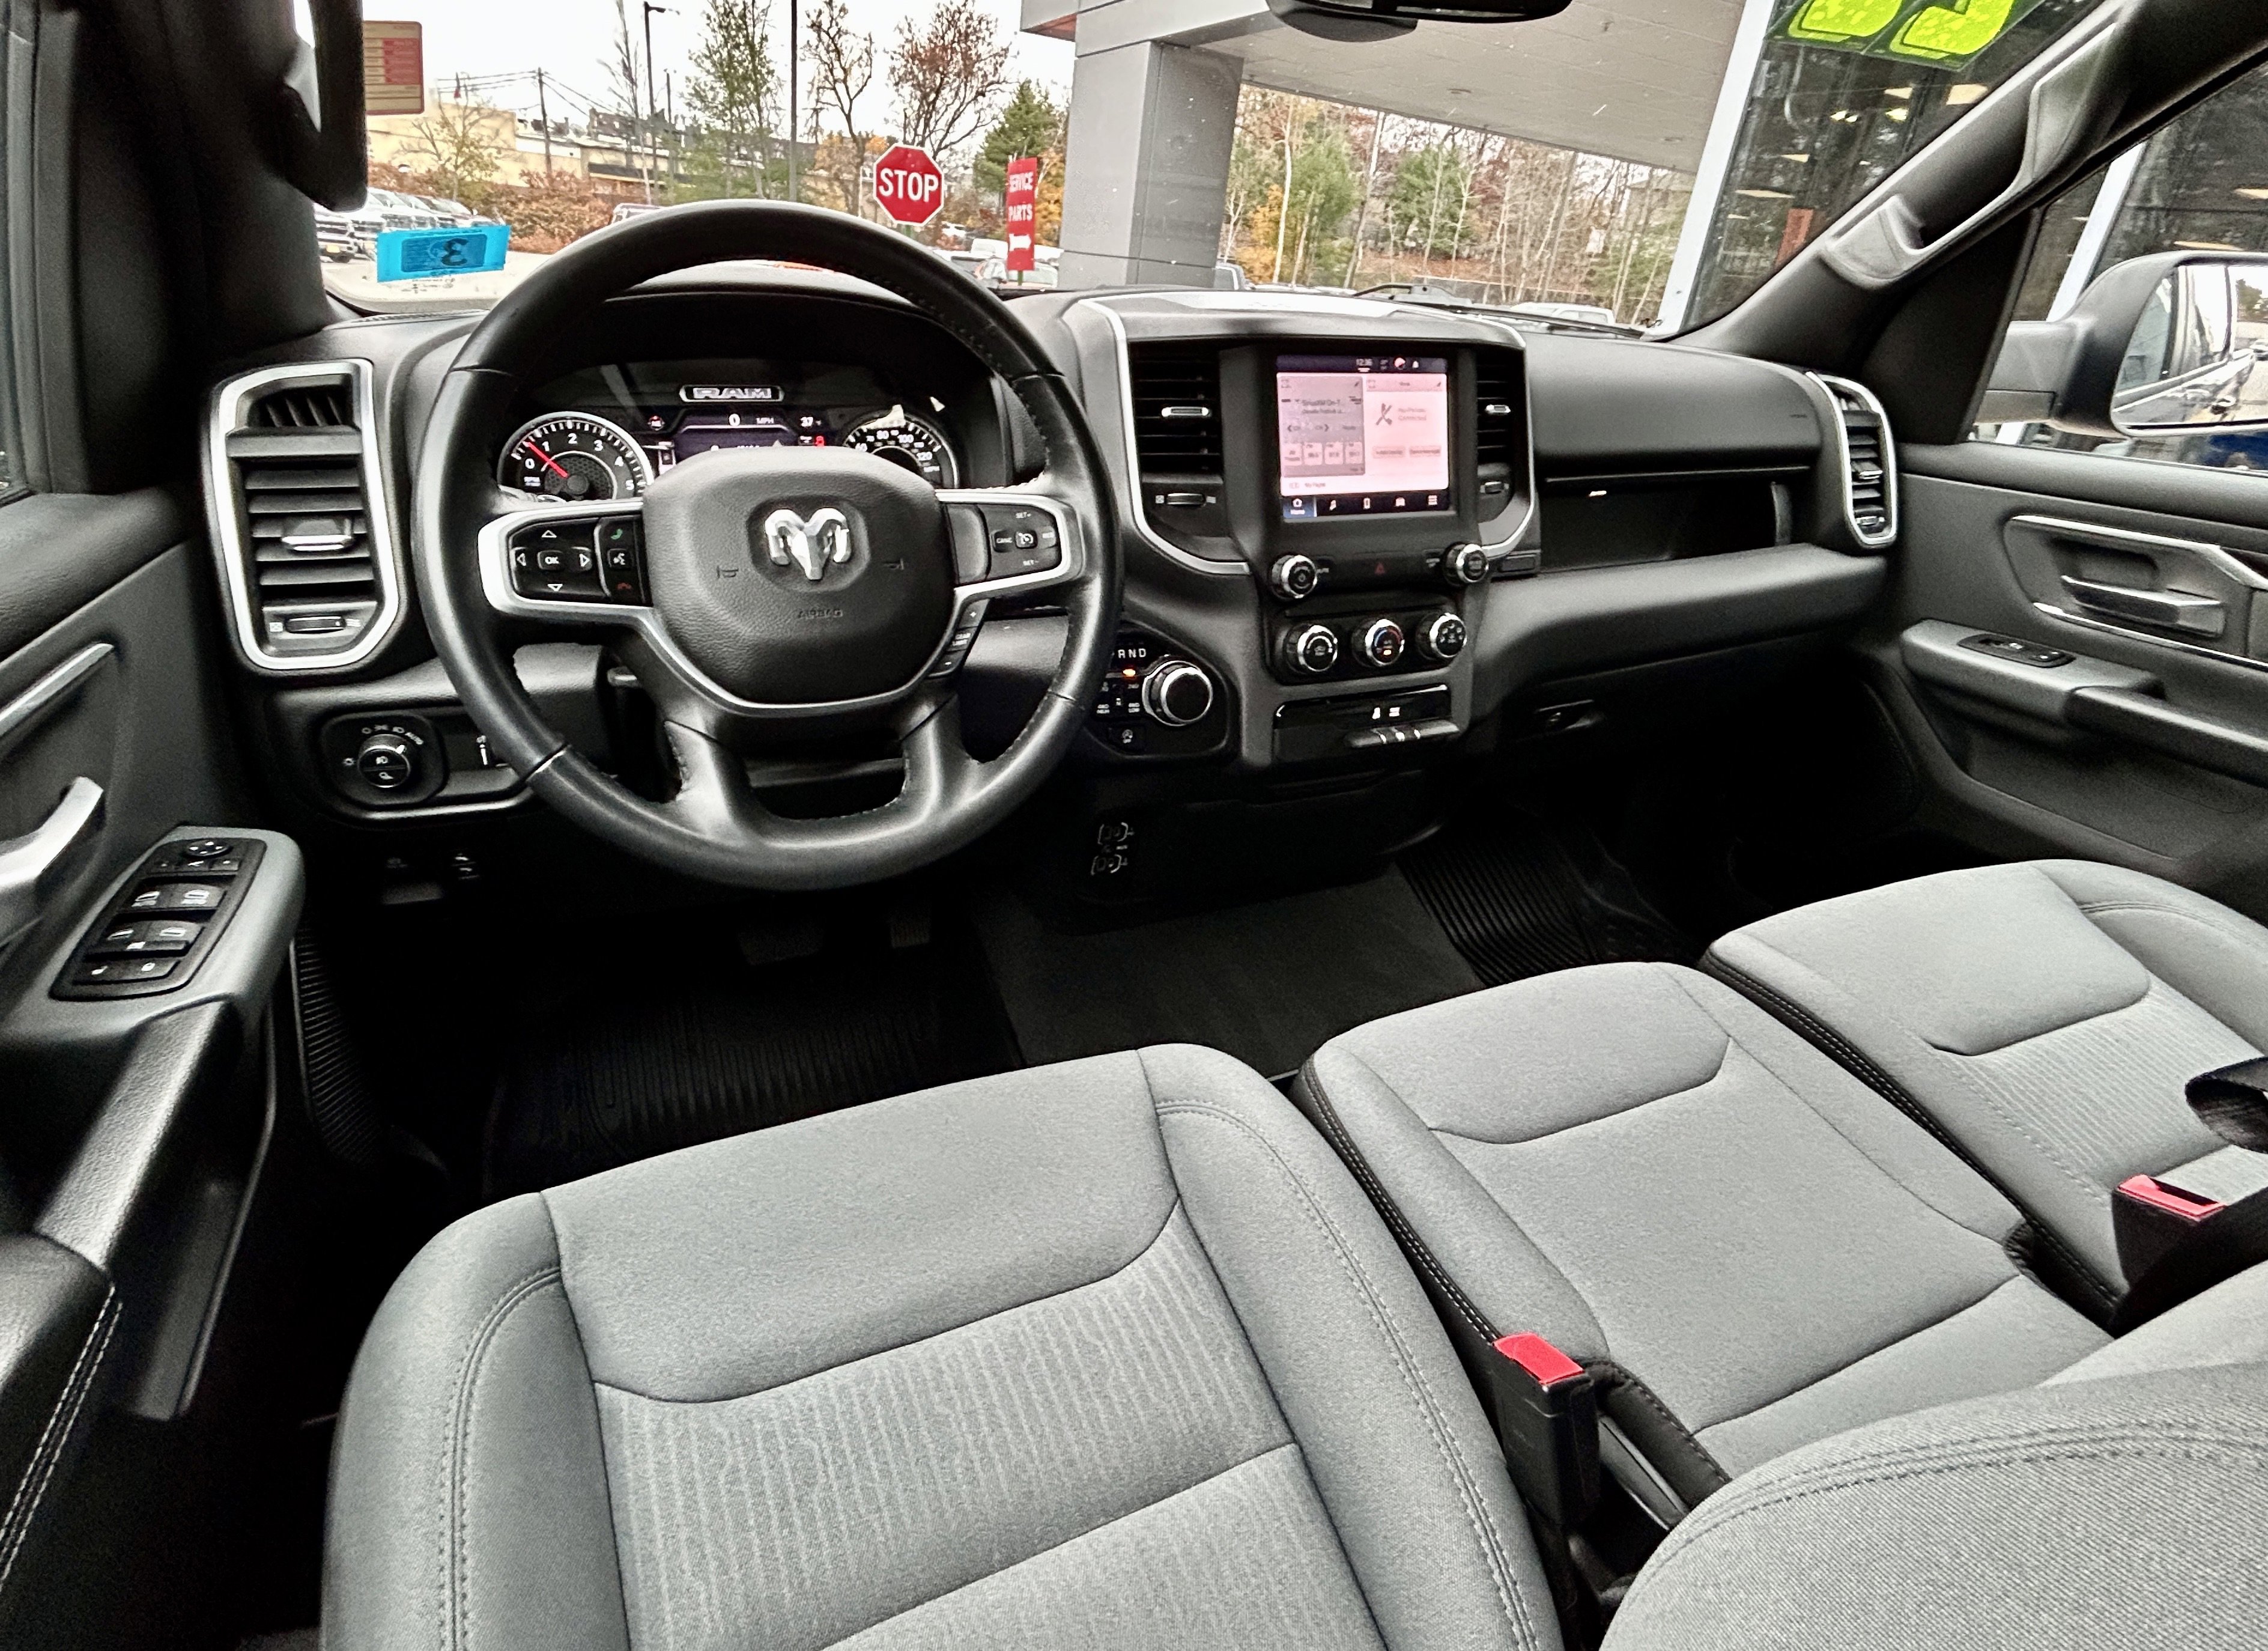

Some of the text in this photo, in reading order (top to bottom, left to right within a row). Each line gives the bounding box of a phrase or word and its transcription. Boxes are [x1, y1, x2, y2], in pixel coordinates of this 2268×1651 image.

[879, 168, 939, 202] STOP
[1008, 204, 1032, 222] PARTS
[692, 388, 772, 398] RAM
[729, 413, 741, 427] 0
[801, 416, 814, 427] 37
[568, 433, 577, 444] 2
[542, 441, 550, 452] 1
[594, 439, 603, 451] 3
[525, 458, 535, 469] 0
[614, 456, 624, 466] 4
[625, 479, 634, 490] 5
[1118, 648, 1147, 658] R N D
